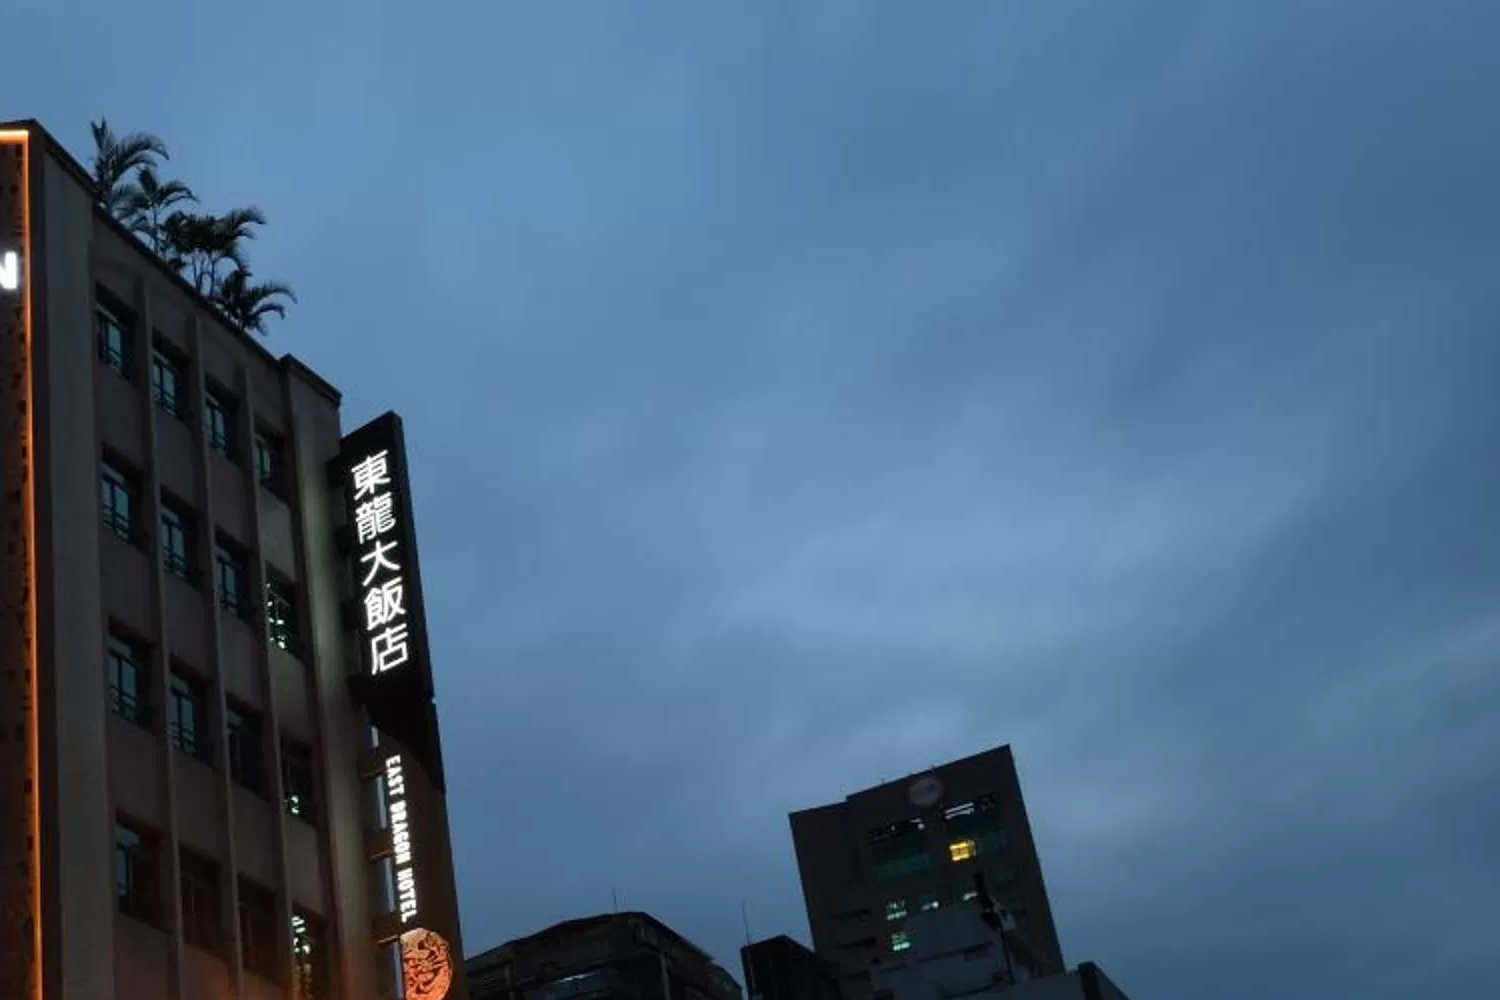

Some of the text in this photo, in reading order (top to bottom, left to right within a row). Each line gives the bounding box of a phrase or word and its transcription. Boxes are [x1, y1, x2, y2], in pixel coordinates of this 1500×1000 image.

[351, 450, 409, 675] 東龍大飯店
[386, 755, 417, 923] EAST DRAGON HOTEL
